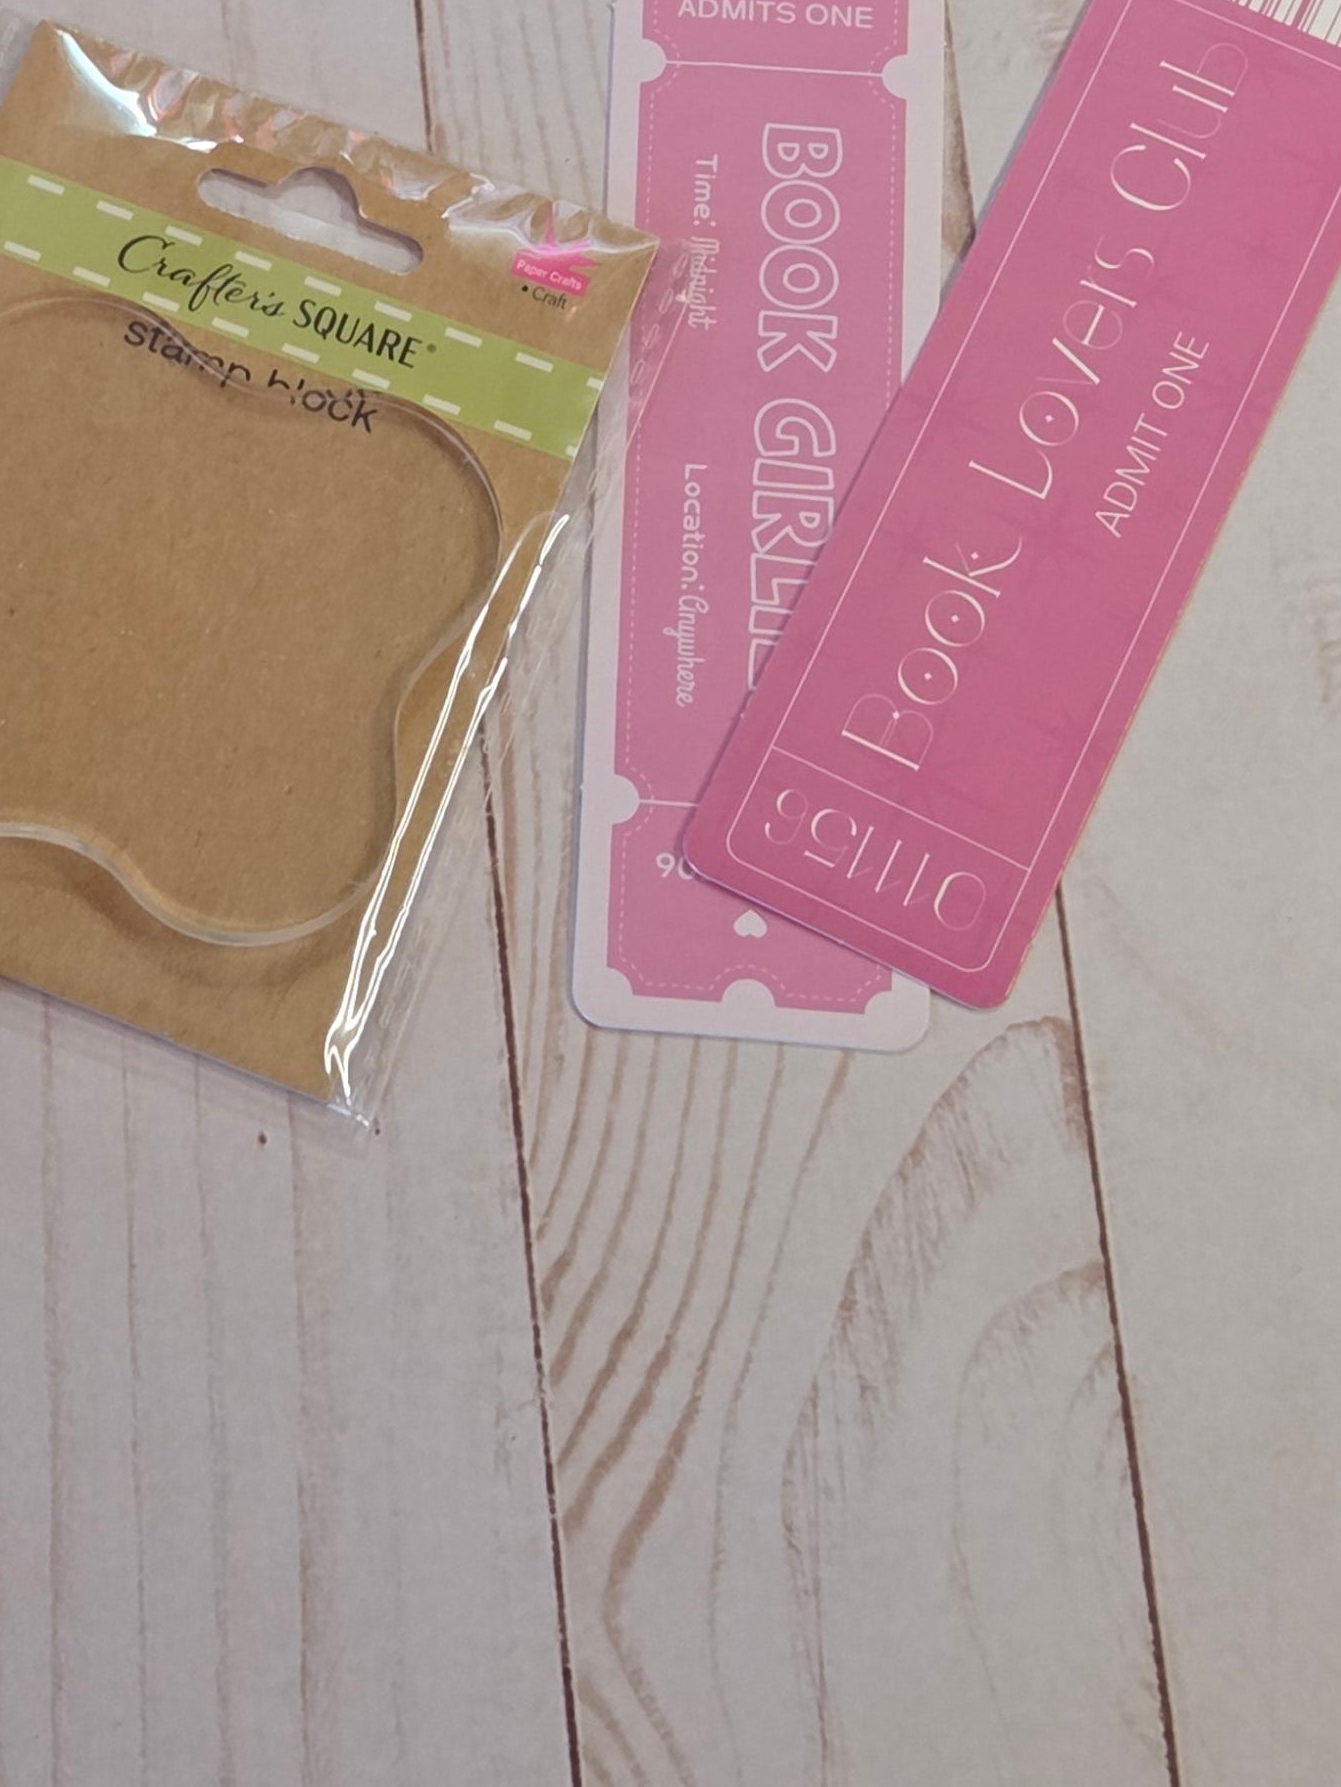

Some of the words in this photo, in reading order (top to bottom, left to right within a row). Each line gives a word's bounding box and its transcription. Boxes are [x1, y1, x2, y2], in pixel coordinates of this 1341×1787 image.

[806, 3, 874, 29] ONE
[692, 153, 719, 229] Time:
[117, 235, 285, 317] Crafter's
[516, 258, 548, 278] Paper
[550, 270, 582, 291] Crafts
[756, 122, 843, 373] BOOK
[1094, 412, 1169, 539] ADMIT
[1151, 330, 1210, 410] ONE
[681, 462, 708, 590] Location:
